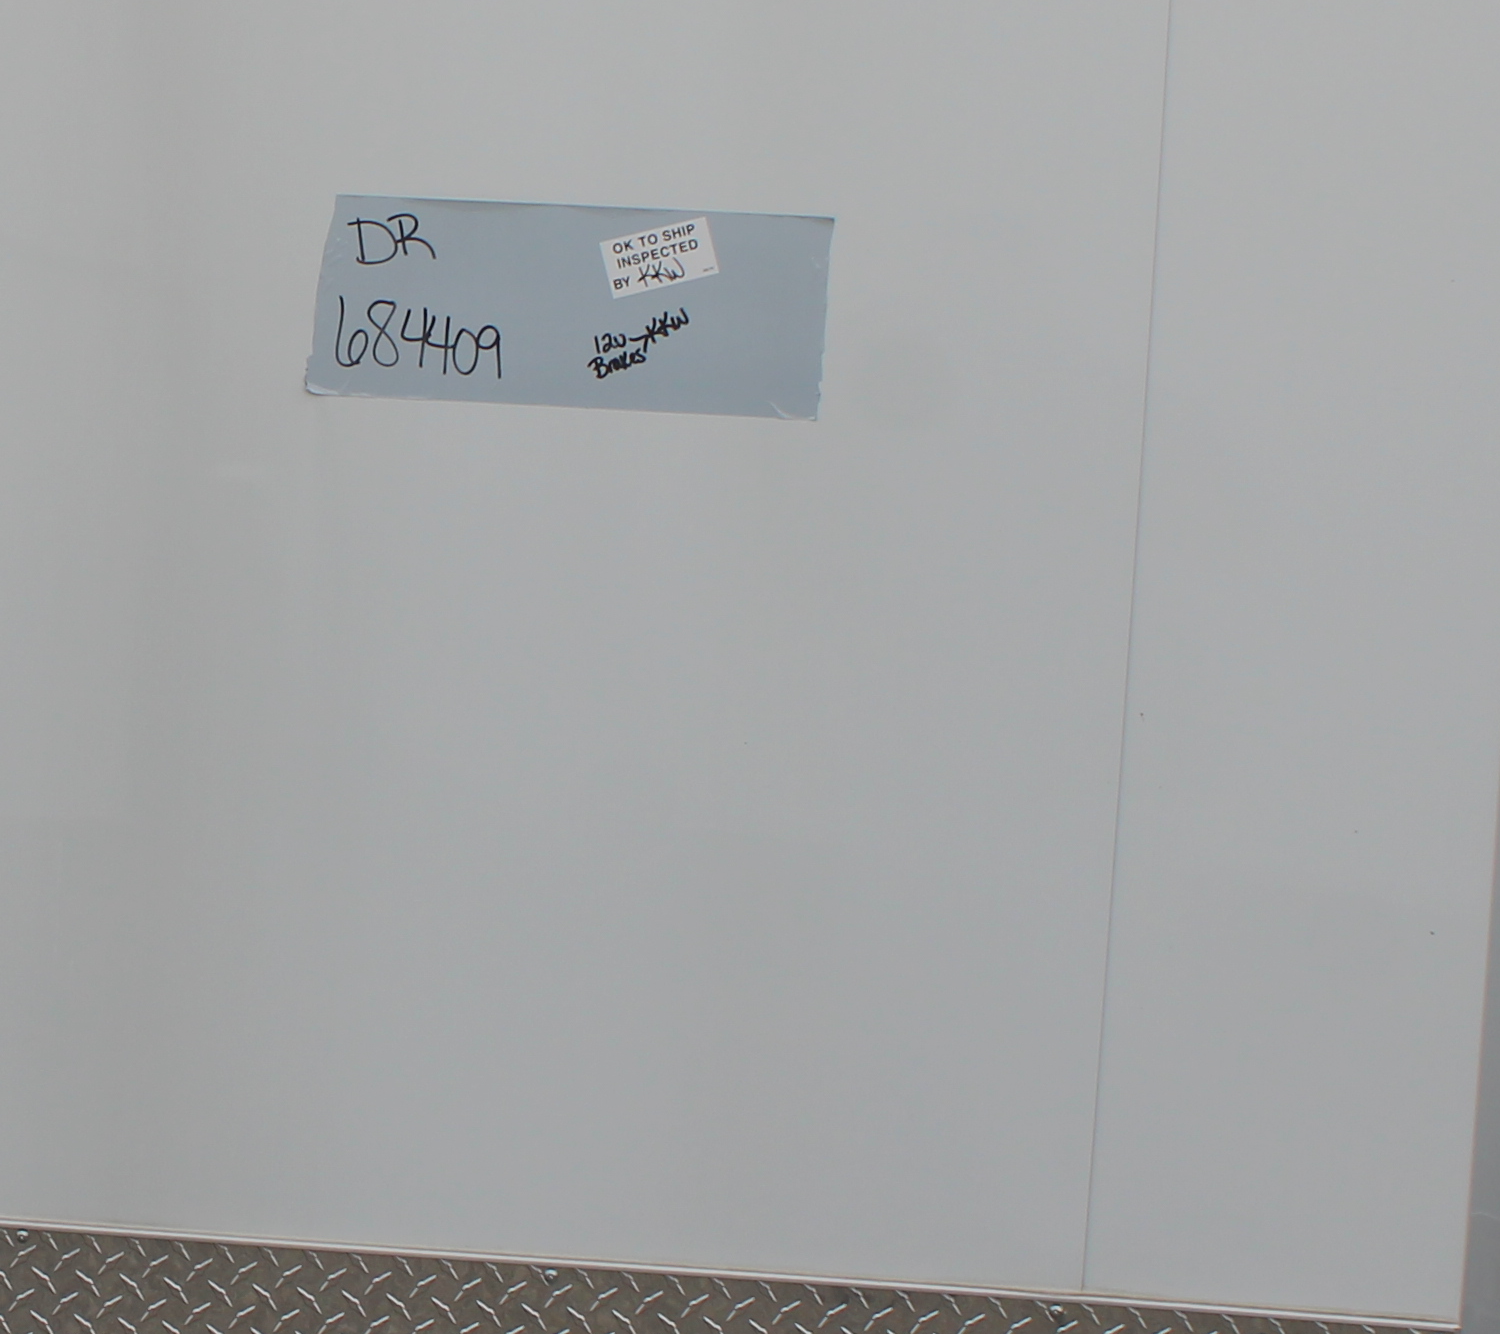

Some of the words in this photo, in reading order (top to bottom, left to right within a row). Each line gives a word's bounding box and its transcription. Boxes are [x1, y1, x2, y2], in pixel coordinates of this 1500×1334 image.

[347, 212, 437, 265] DR
[612, 239, 634, 255] OK
[638, 233, 658, 248] TO
[662, 223, 696, 242] SHIP
[616, 238, 699, 269] INSPECTED
[613, 276, 631, 290] BY
[335, 294, 502, 380] 684409
